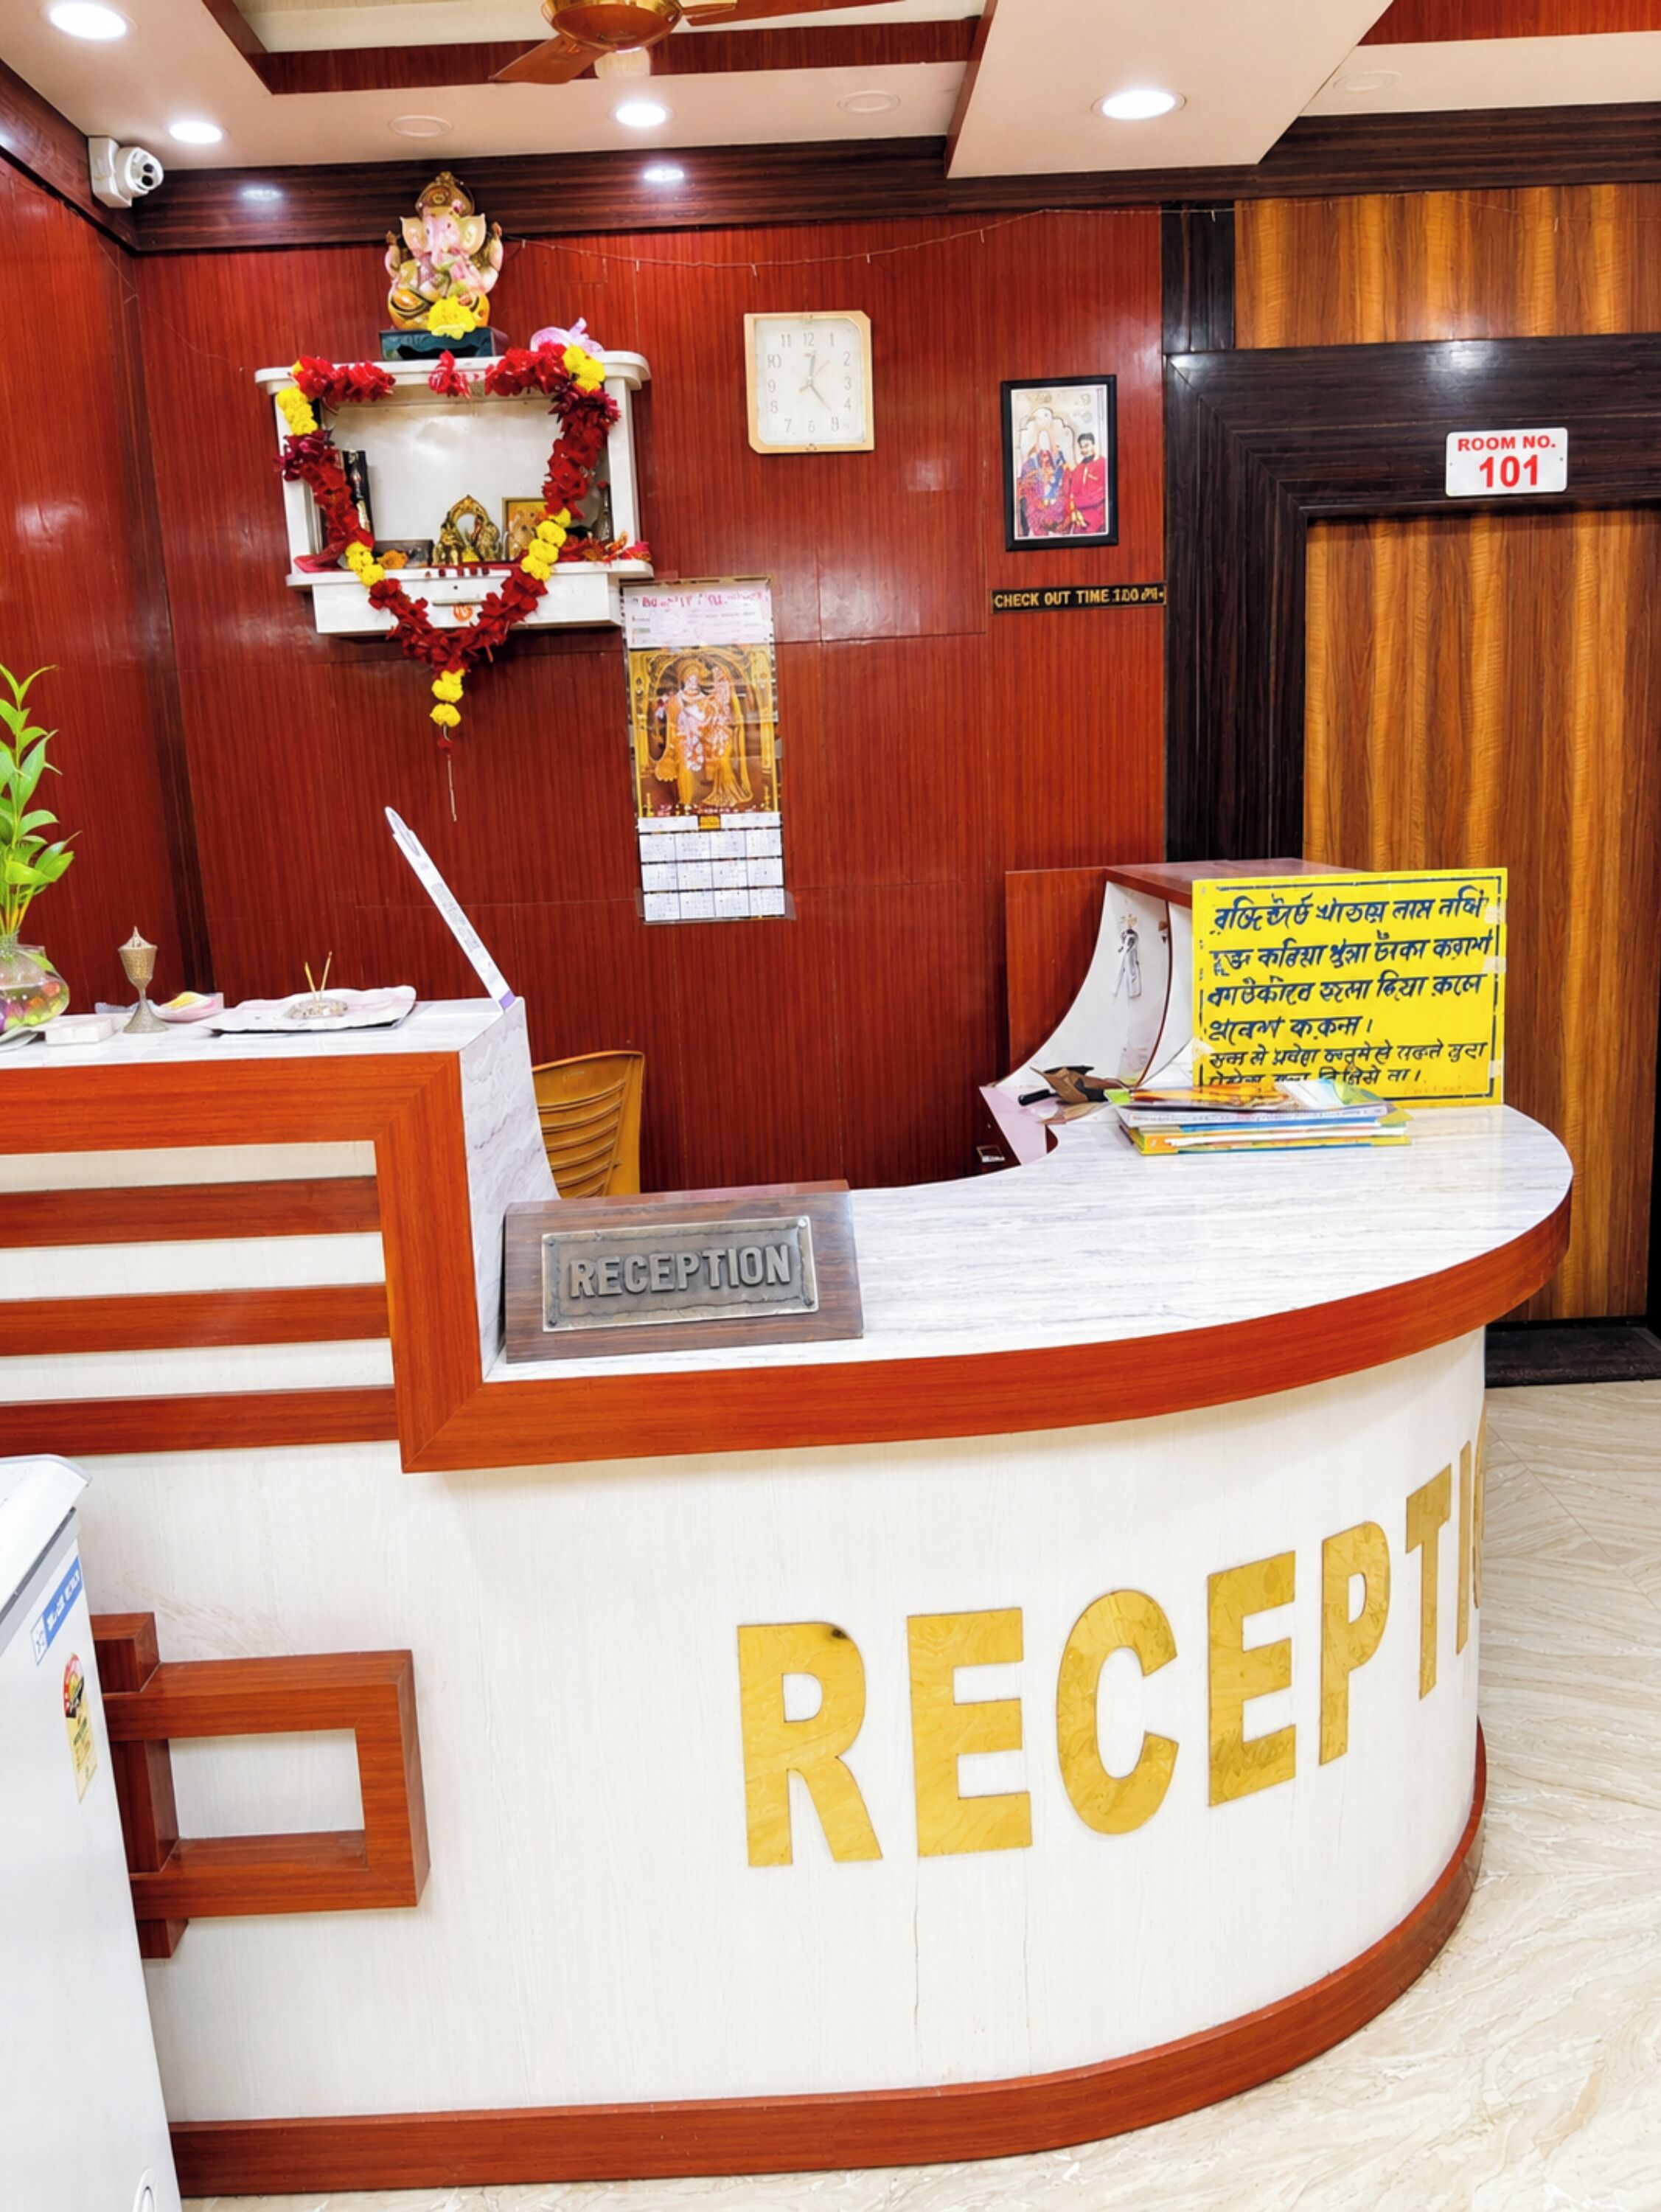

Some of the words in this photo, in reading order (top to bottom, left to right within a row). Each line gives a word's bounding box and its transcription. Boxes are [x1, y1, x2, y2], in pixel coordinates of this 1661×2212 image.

[1458, 437, 1516, 451] ROOM
[1522, 435, 1556, 449] NO.
[1479, 454, 1538, 488] 101
[995, 592, 1040, 608] CHECK
[1044, 590, 1071, 605] OUT
[1076, 589, 1109, 604] TIME
[569, 1243, 792, 1300] RECEPTION
[737, 1405, 1486, 1867] RECEPTI
